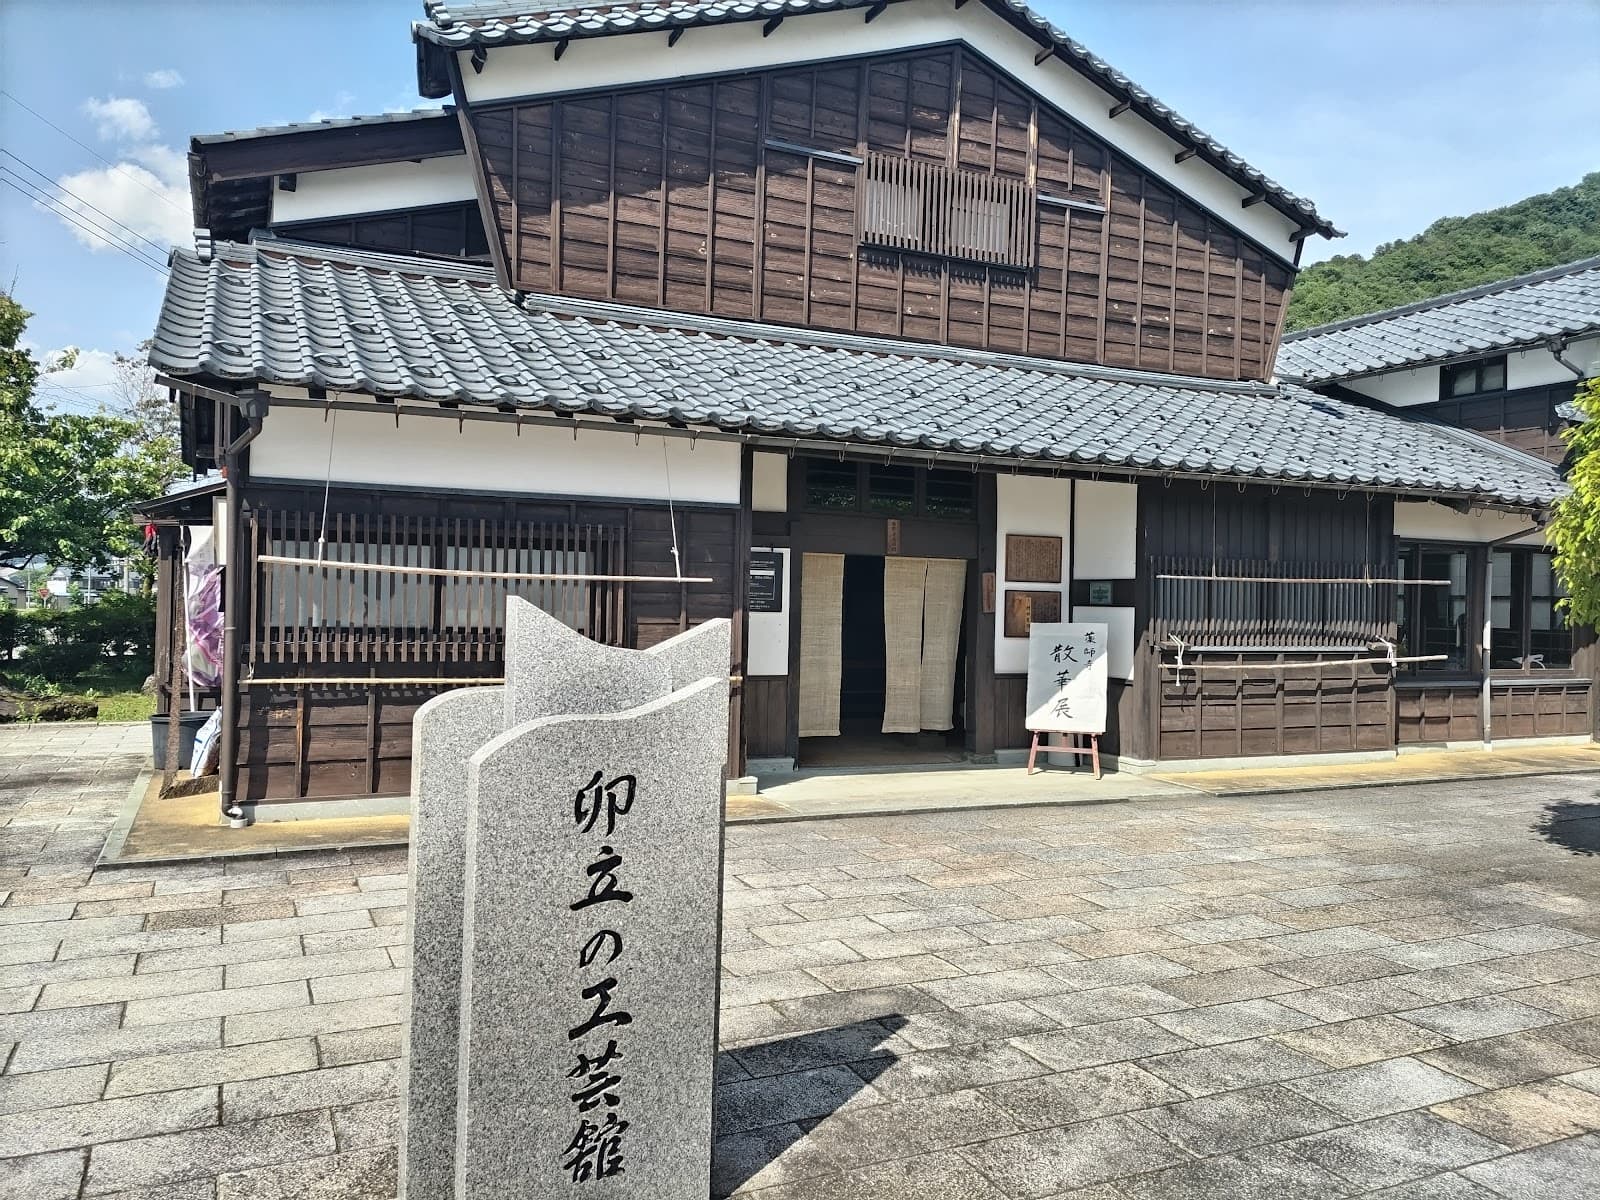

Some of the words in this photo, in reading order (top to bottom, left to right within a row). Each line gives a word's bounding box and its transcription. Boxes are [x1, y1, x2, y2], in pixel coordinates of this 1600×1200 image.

[1049, 643, 1079, 719] 散華展
[562, 770, 637, 1183] 卯立の工芸館
